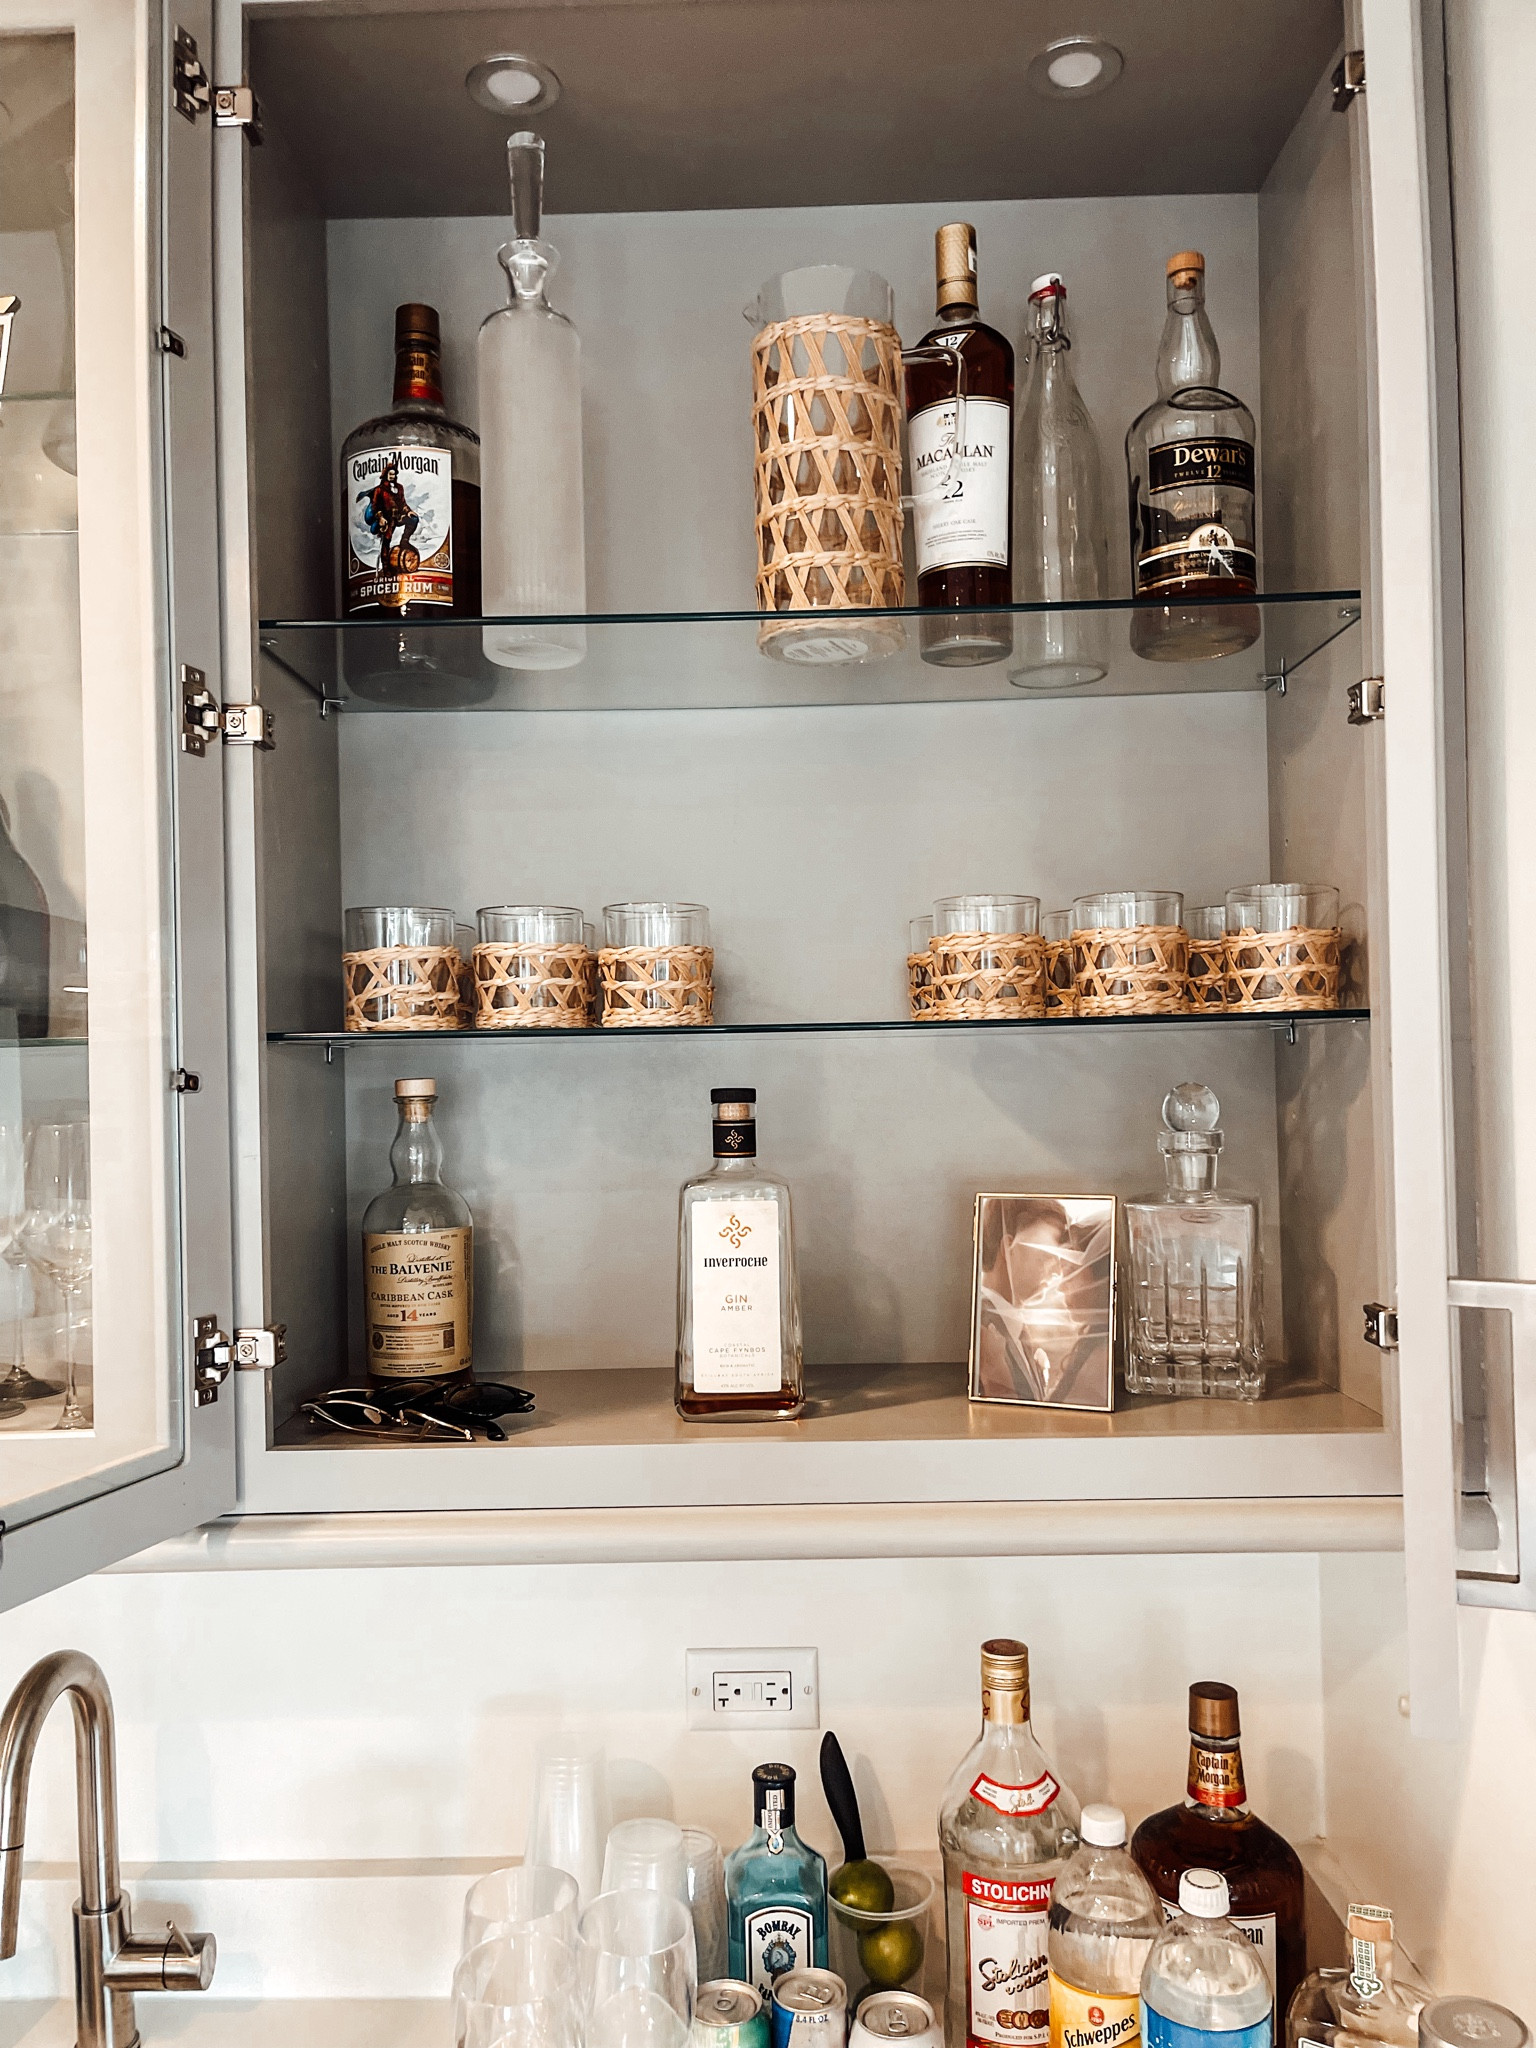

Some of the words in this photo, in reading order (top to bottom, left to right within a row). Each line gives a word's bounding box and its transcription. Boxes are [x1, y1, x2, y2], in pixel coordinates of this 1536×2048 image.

[945, 336, 958, 347] 12
[916, 442, 995, 471] MACALLAN
[1173, 447, 1246, 467] Dewar's
[353, 454, 389, 482] Captain
[389, 452, 438, 475] Morgan
[1174, 469, 1205, 478] TWELVE
[1206, 464, 1222, 478] 12
[360, 582, 399, 597] SPICED
[405, 582, 433, 594] RUM
[429, 1240, 451, 1251] WHISKY
[371, 1264, 387, 1275] THE
[390, 1261, 453, 1275] BALVENIE
[371, 1292, 425, 1301] CARIBBEAN
[428, 1290, 454, 1300] CASK
[725, 1294, 748, 1304] GIN
[401, 1310, 418, 1322] 14
[1197, 1751, 1229, 1770] Captain
[1196, 1768, 1230, 1787] Morgan
[756, 1920, 802, 1941] BOMBAY
[796, 2015, 807, 2023] 8.4
[817, 2014, 829, 2023] OZ
[1064, 2013, 1137, 2048] Schweppes
